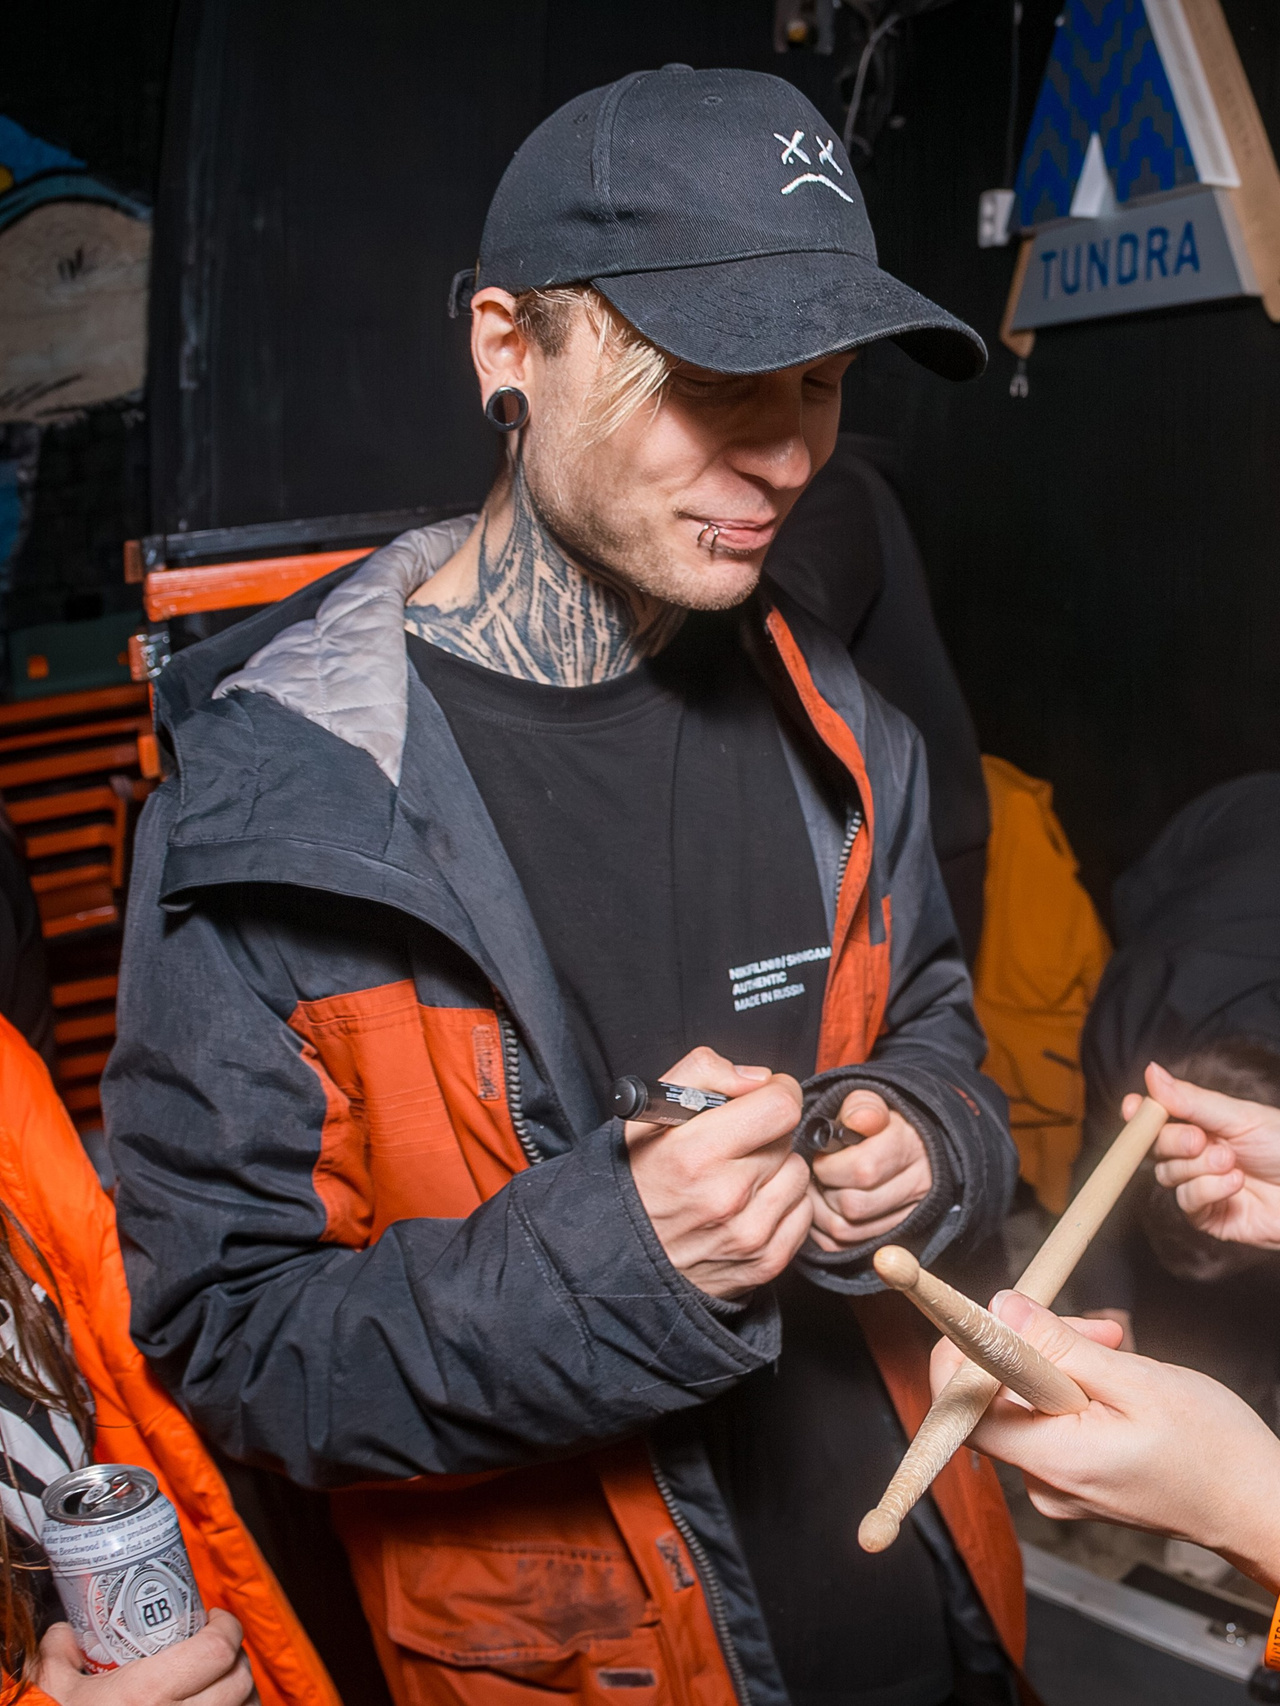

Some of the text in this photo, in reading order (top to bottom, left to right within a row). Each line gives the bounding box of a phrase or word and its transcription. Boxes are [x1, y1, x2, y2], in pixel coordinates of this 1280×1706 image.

[1040, 221, 1200, 300] TUNDRA
[732, 971, 787, 996] AUTHENTIC
[734, 982, 806, 1012] MADE IN RUSSIA
[59, 1541, 99, 1557] Beechwood
[127, 1521, 158, 1540] produces
[83, 1526, 104, 1540] which
[107, 1520, 126, 1533] costs
[127, 1516, 136, 1526] so
[136, 1508, 153, 1523] much
[92, 1553, 108, 1565] you
[126, 1541, 142, 1555] find
[142, 1597, 172, 1627] AB
